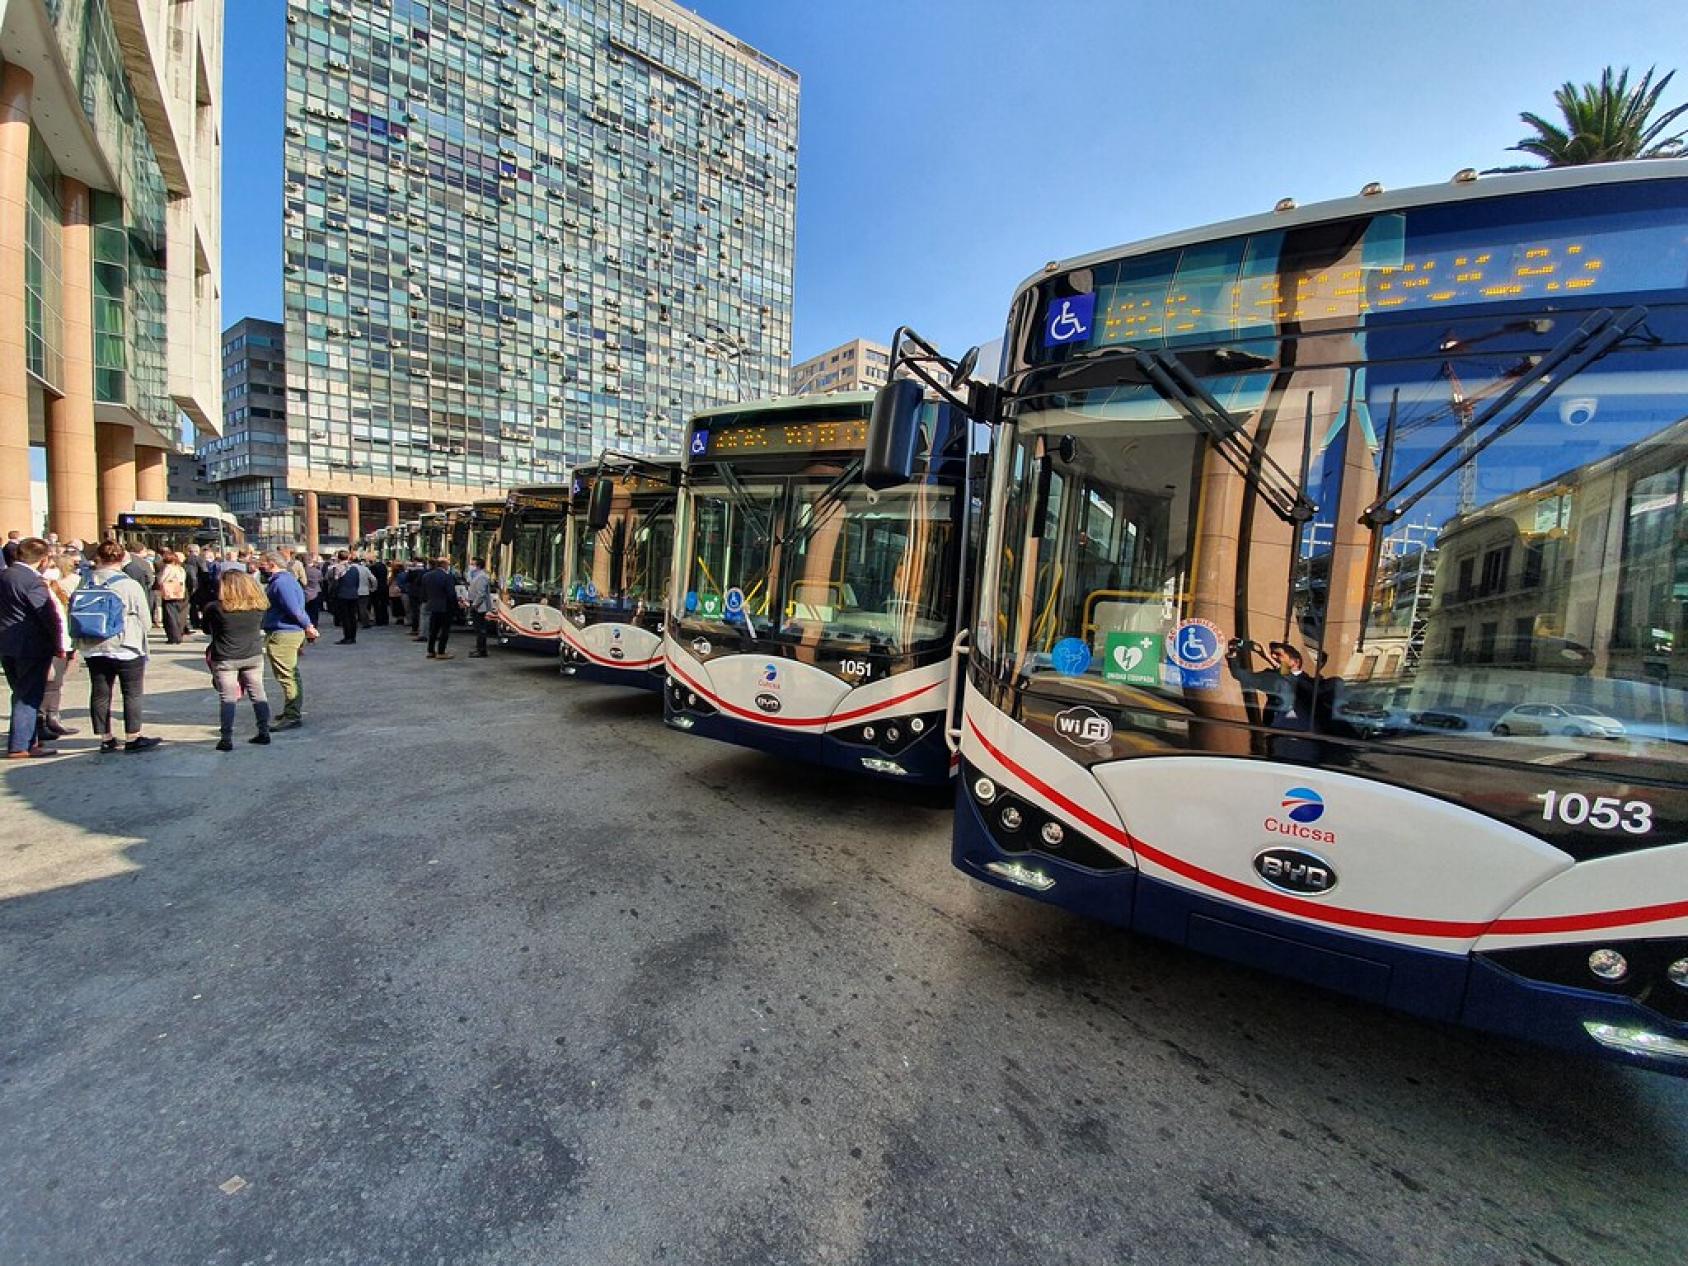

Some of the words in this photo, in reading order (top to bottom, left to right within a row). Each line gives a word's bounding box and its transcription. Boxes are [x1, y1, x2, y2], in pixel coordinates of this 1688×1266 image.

[839, 659, 872, 677] 1051
[1537, 789, 1653, 834] 1053
[1264, 817, 1336, 844] Cutcsa
[1262, 855, 1328, 889] BYD
